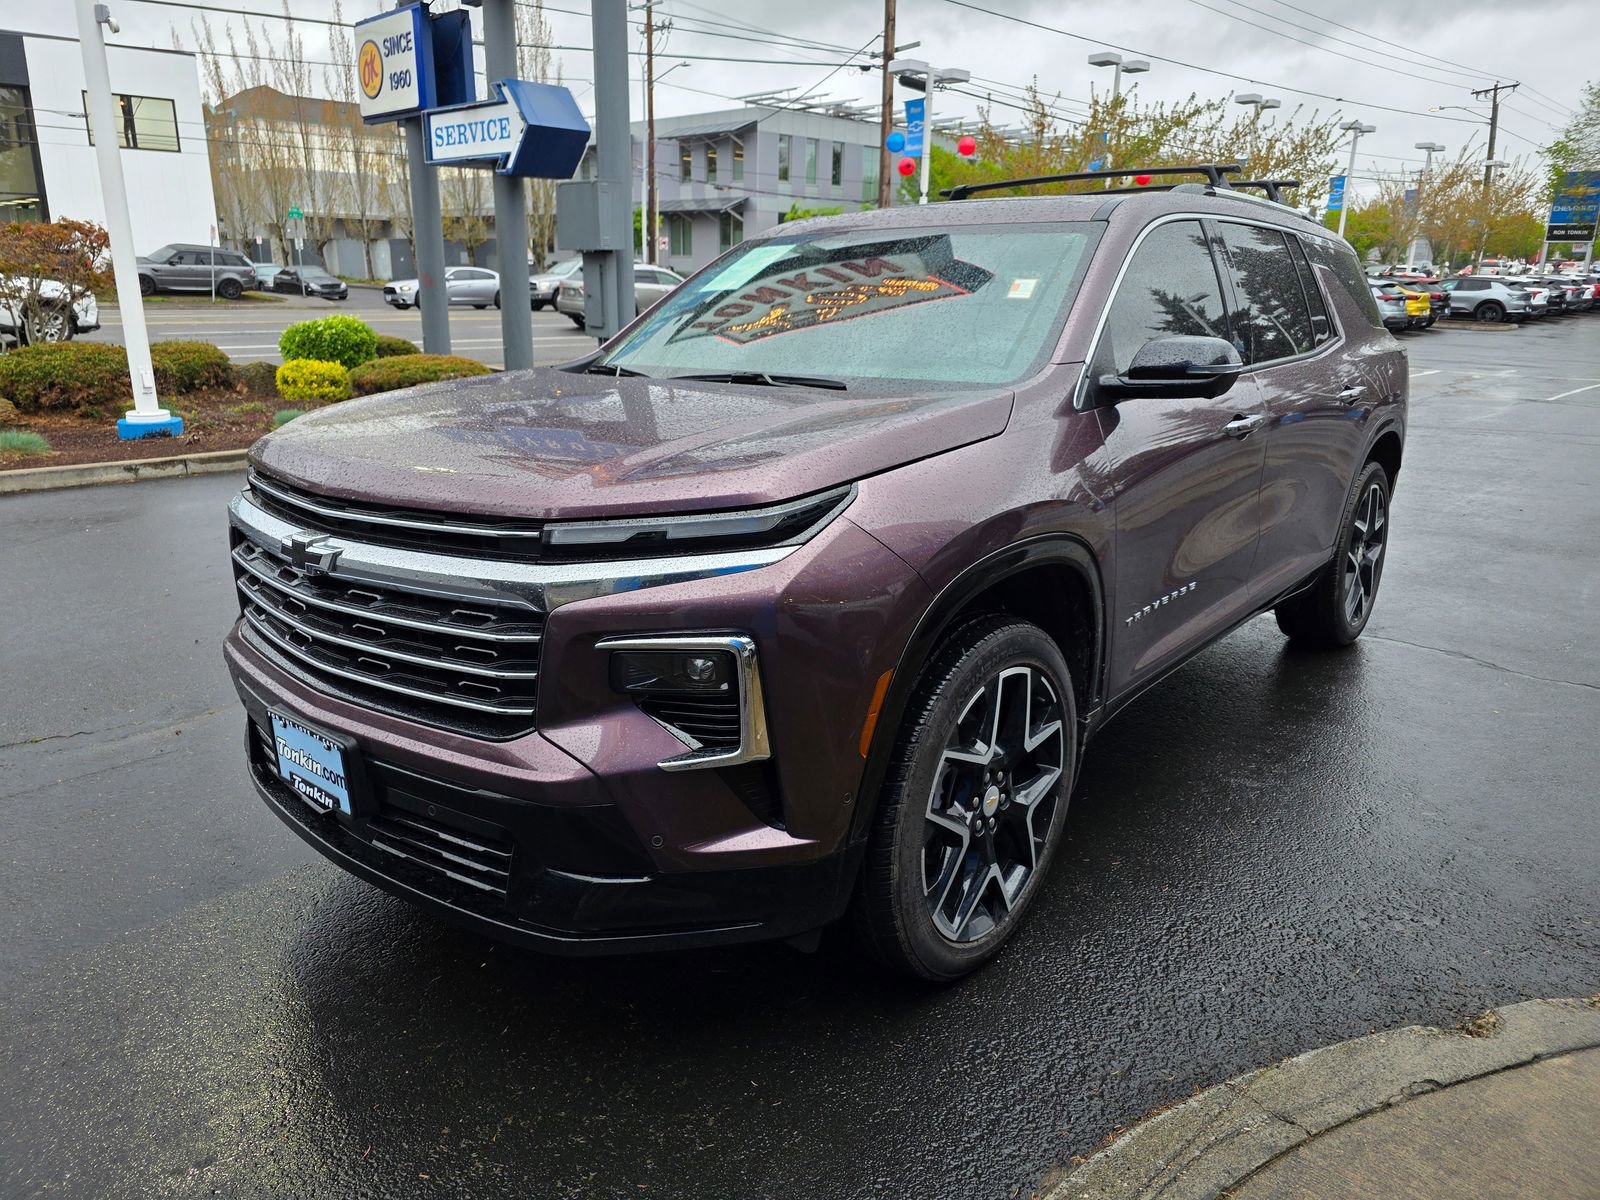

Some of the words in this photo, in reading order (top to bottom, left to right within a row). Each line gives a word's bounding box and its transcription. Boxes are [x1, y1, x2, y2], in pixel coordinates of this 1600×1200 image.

[383, 31, 413, 58] SINCE
[362, 50, 379, 88] OK
[389, 68, 412, 91] 1960
[434, 117, 511, 147] SERVICE
[1125, 581, 1197, 627] TRAVERSE
[276, 736, 348, 791] Tonkin.com
[292, 774, 333, 809] Tonkin
